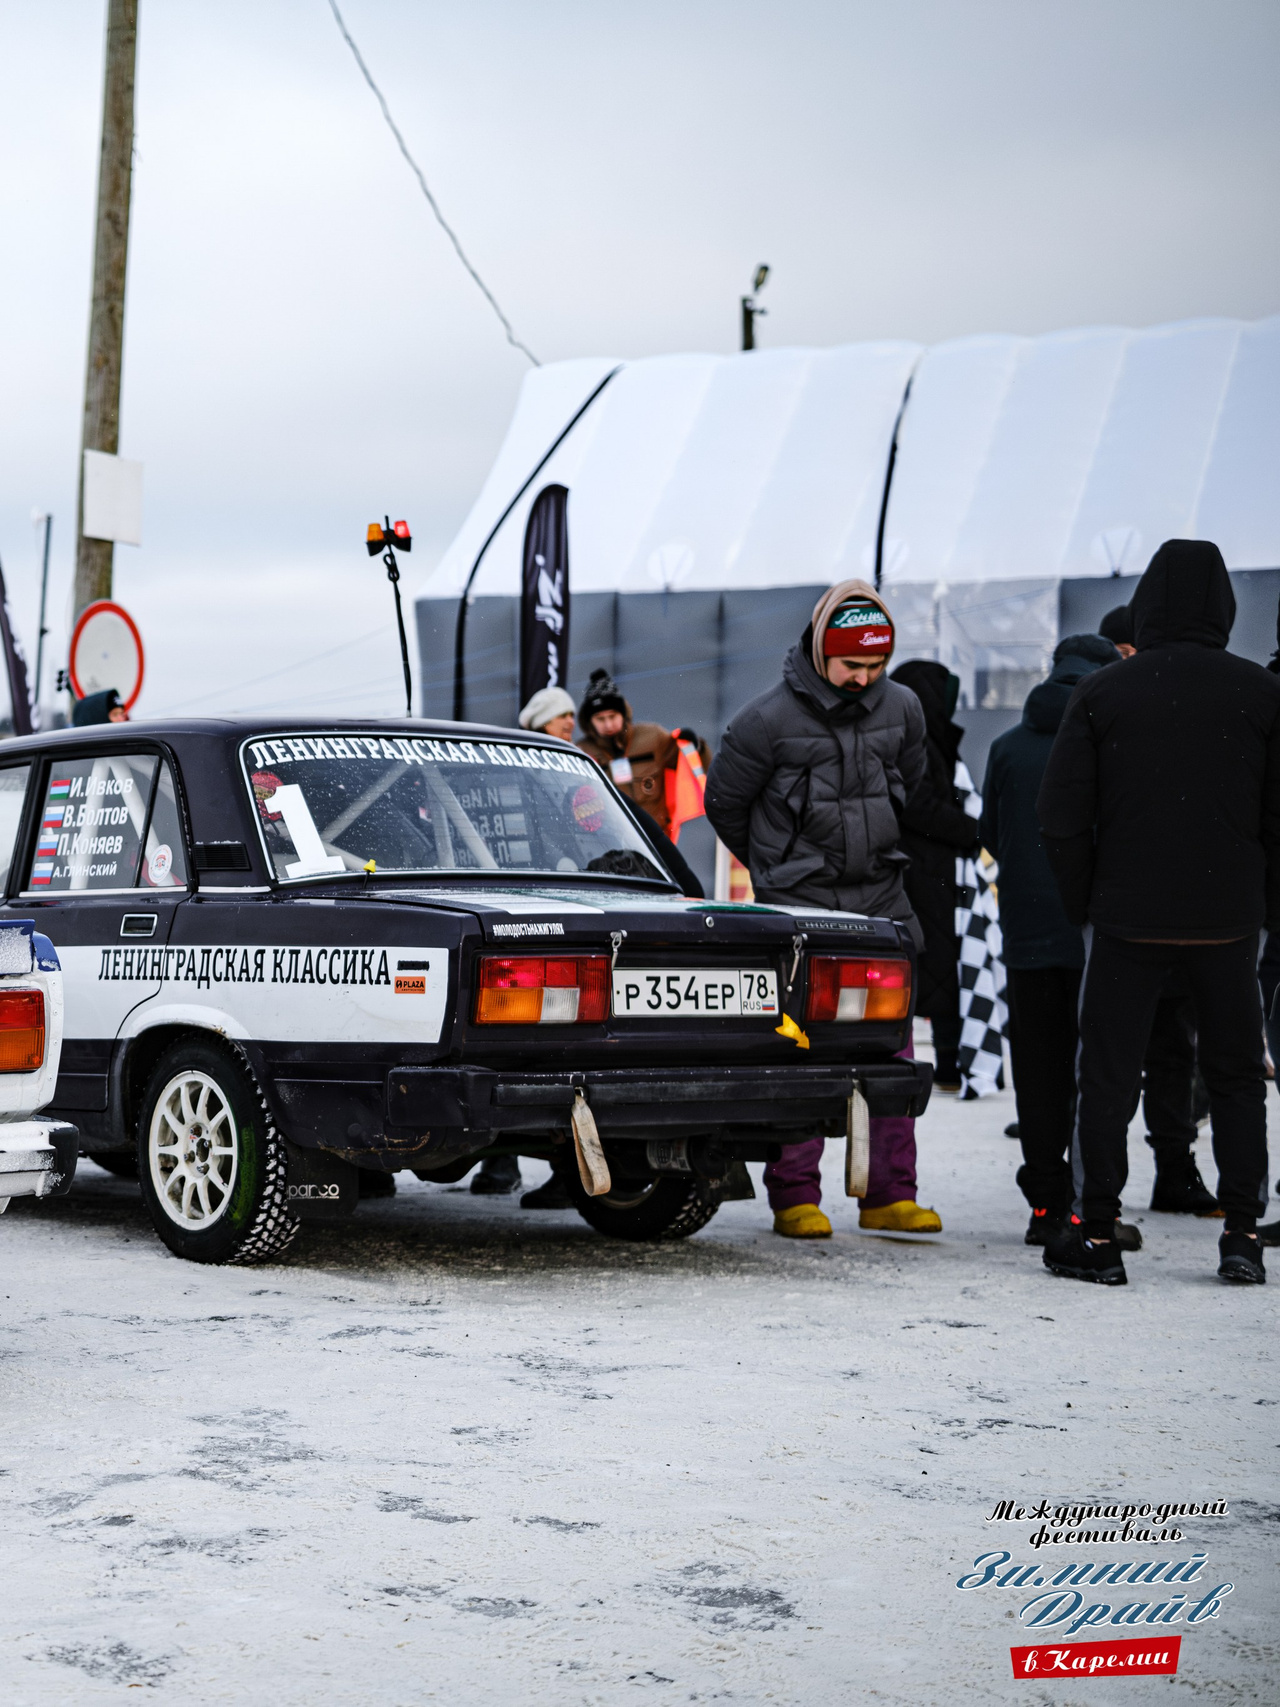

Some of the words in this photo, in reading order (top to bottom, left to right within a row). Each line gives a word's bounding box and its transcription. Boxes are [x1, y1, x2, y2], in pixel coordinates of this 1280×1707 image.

[248, 737, 484, 768] ЛЕНИНГРАДСКАЯ
[69, 777, 134, 798] И.Ивков
[62, 804, 130, 828] В.Болтов
[264, 783, 346, 878] 1
[56, 833, 124, 857] П.Коняев
[98, 948, 265, 989] ЛЕНИНГРАДСКАЯ
[271, 949, 391, 985] КЛАССИКА
[742, 1000, 762, 1011] RUS
[286, 1183, 340, 1200] parco
